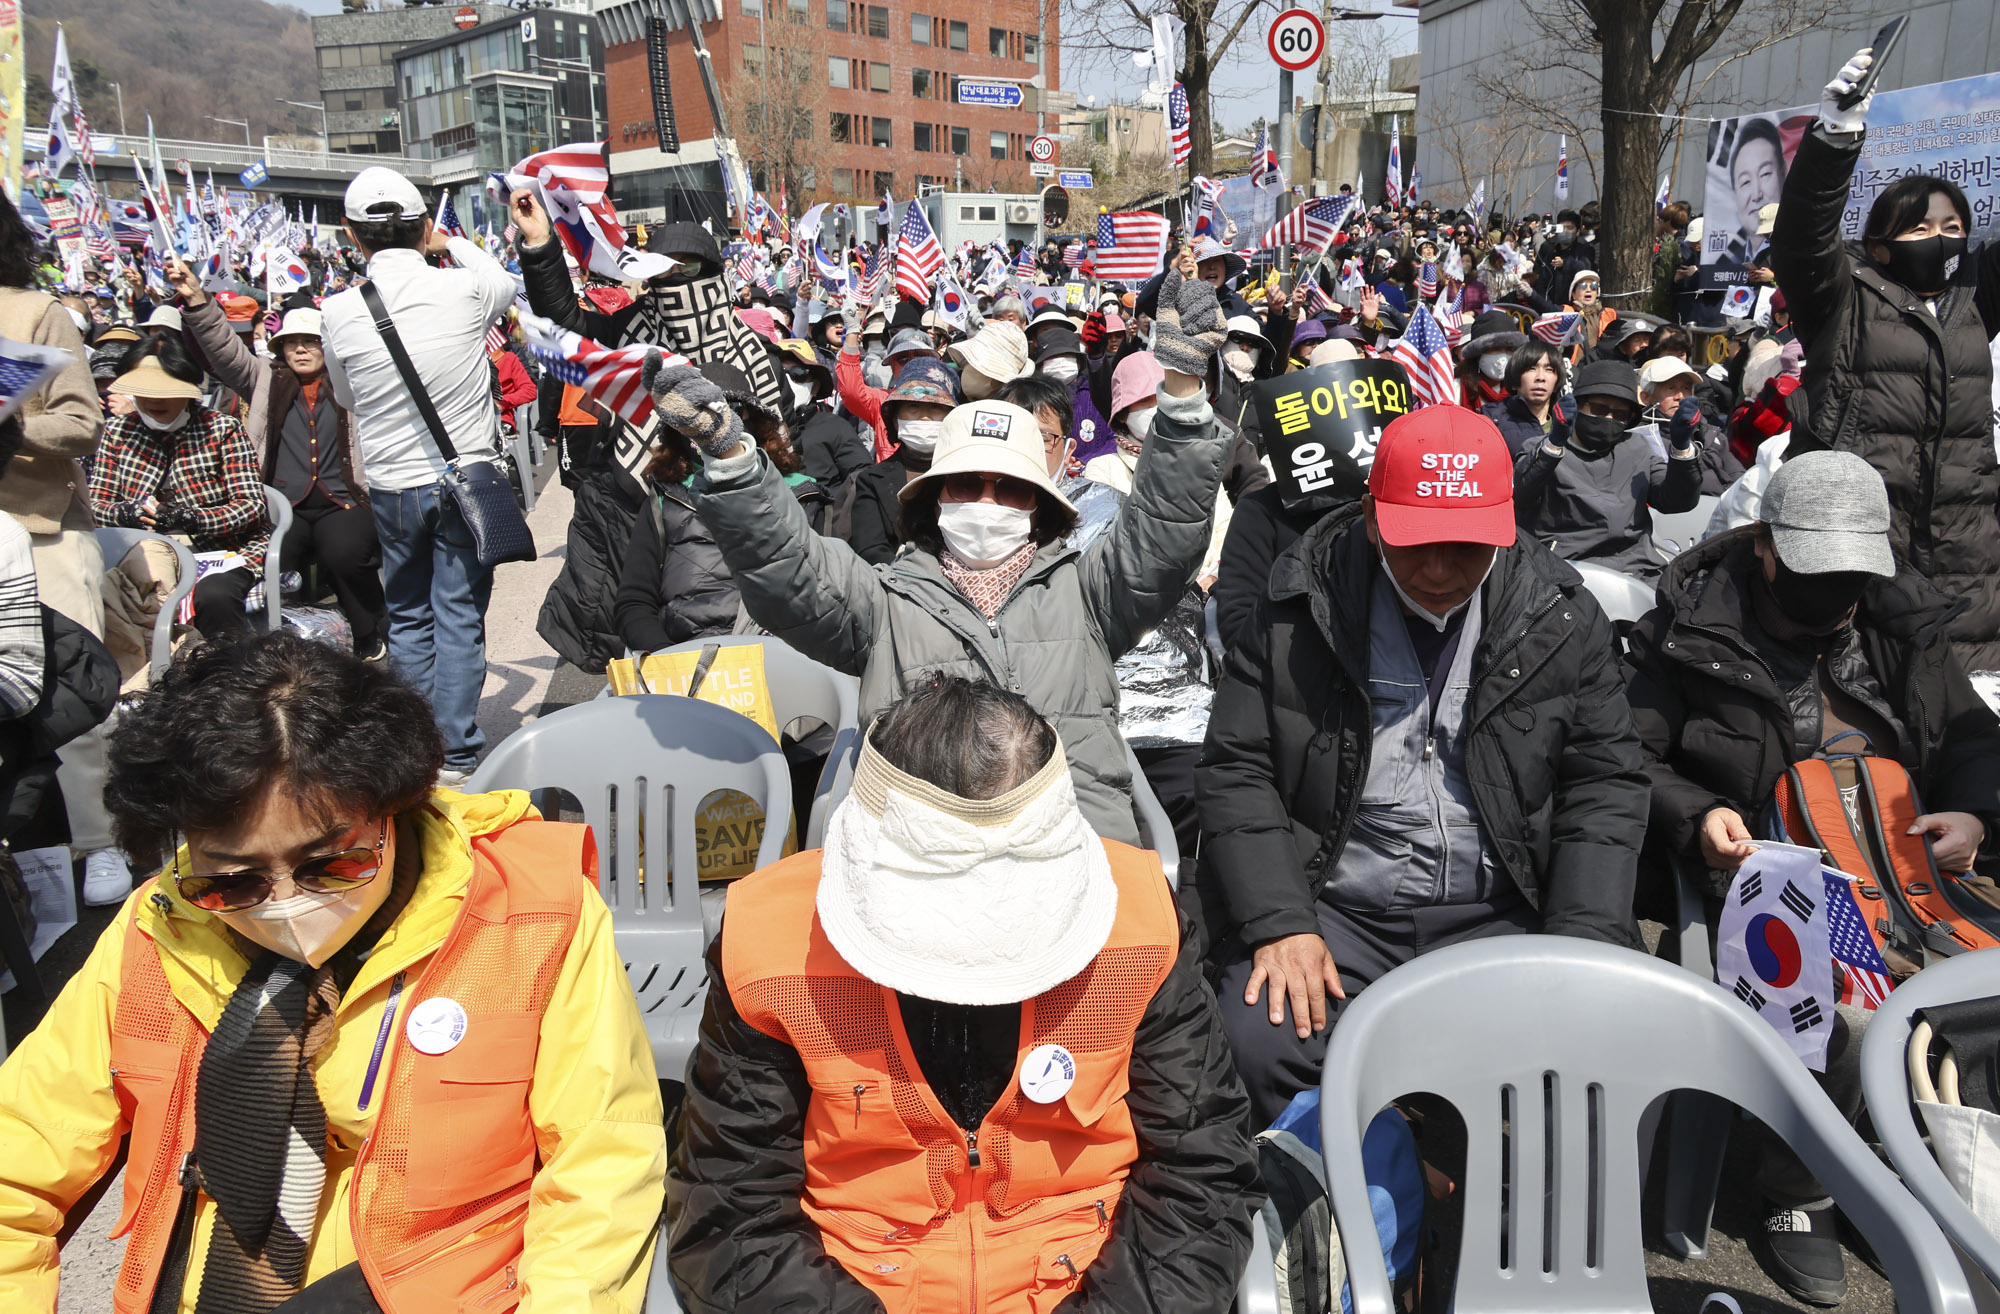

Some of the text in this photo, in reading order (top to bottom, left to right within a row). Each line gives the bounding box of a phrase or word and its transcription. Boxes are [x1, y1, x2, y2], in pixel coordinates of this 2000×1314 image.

[1280, 27, 1313, 53] 60
[961, 85, 1006, 97] 한남대로36길
[1886, 122, 1914, 138] 국민을
[1916, 119, 1938, 135] 위한,
[1940, 114, 1971, 131] 국민이
[1035, 143, 1051, 155] 30
[1875, 141, 1911, 157] 대통령님
[1912, 134, 1954, 153] 힘내세요!
[1956, 129, 1988, 145] 우리가
[1843, 206, 1861, 236] 열
[1274, 376, 1409, 436] 돌아와요!
[975, 429, 1006, 438] 대한민국
[1291, 442, 1335, 493] 윤
[1421, 453, 1480, 470] STOP
[1436, 470, 1466, 482] THE
[1416, 481, 1483, 498] STEAL
[666, 667, 753, 697] LITLE
[698, 848, 760, 869] UR LIF
[1764, 1215, 1791, 1226] ORTH
[1767, 1223, 1791, 1232] FACE
